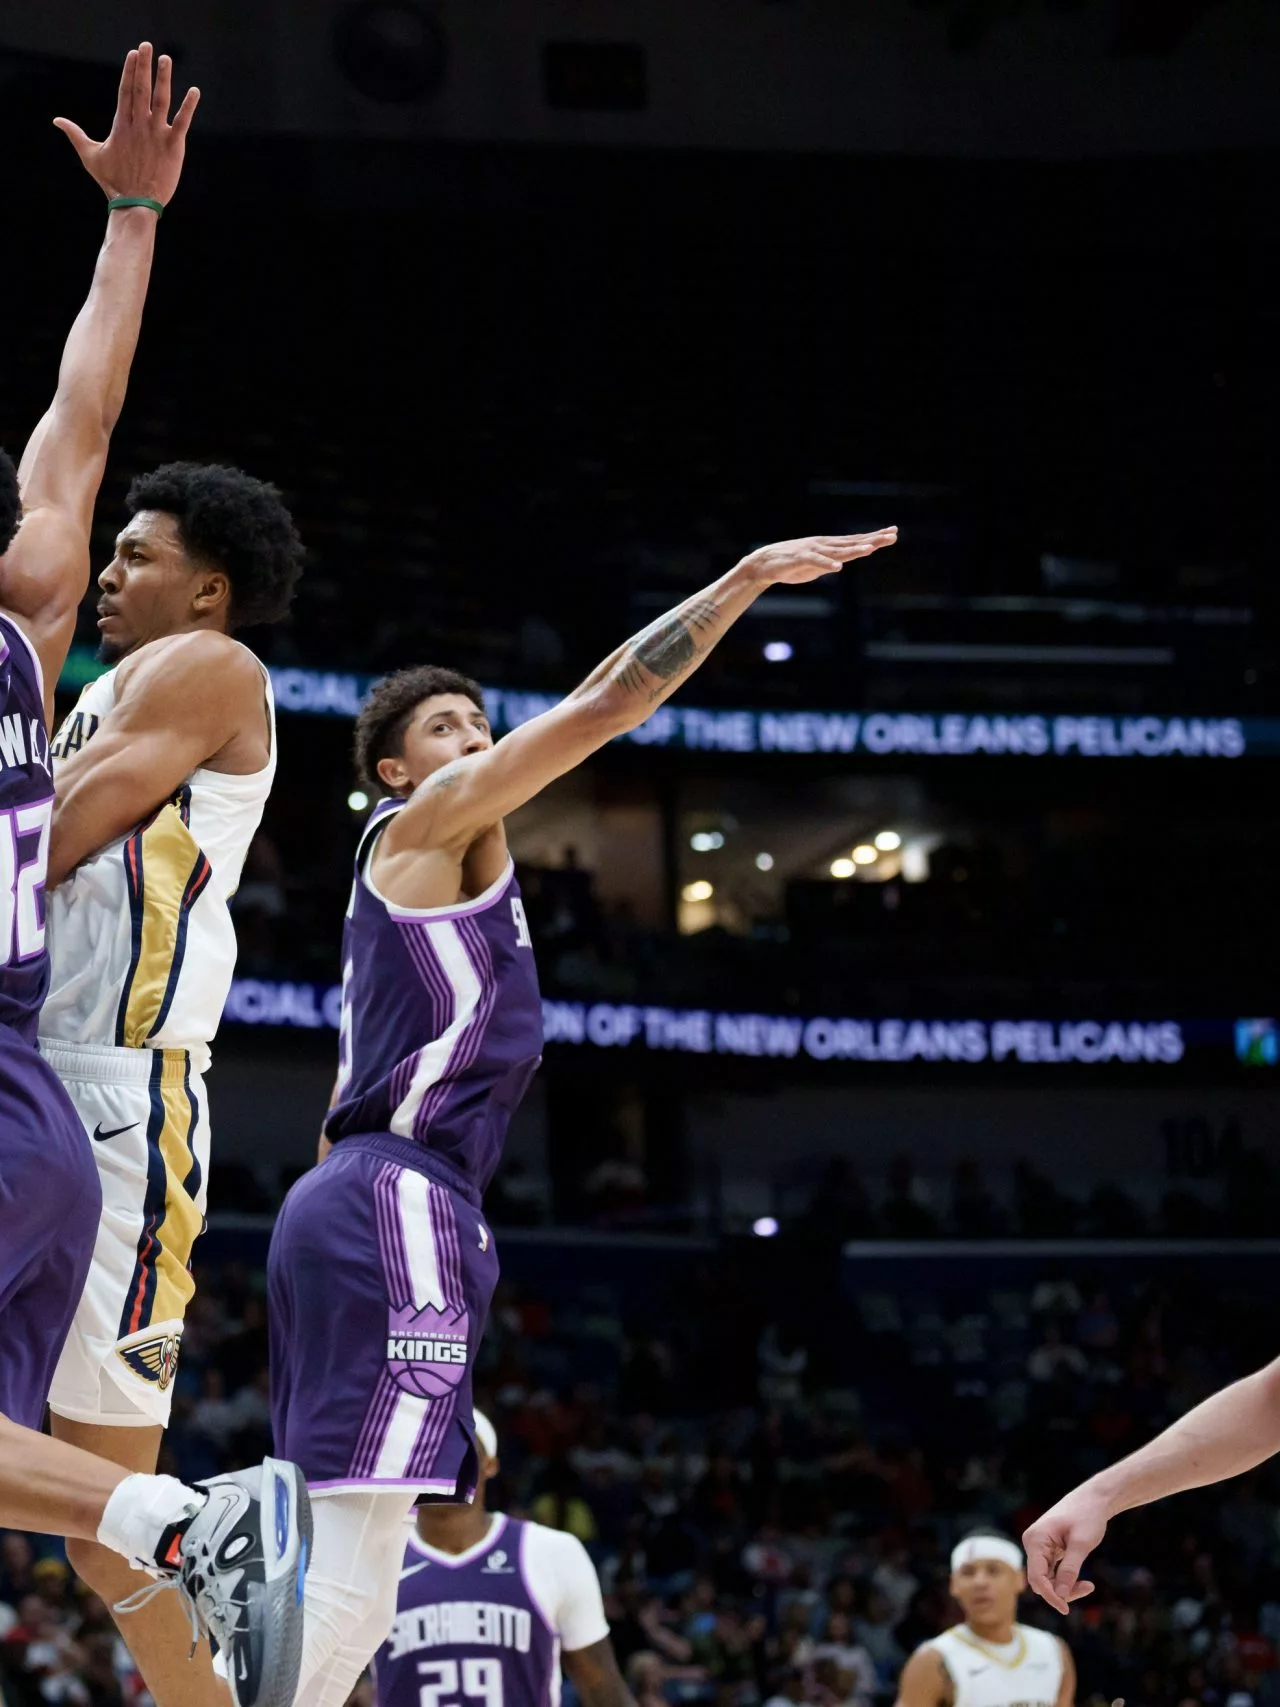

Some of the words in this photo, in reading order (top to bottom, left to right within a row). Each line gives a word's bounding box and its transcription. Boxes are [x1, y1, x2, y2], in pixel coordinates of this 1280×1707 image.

[682, 708, 756, 752] THE
[759, 711, 860, 753] NEW
[862, 713, 1050, 755] ORLEANS
[1053, 715, 1245, 757] PELICANS
[587, 1003, 641, 1047] OF
[642, 1007, 712, 1053] THE
[715, 1013, 802, 1058] NEW
[803, 1018, 988, 1061] ORLEANS
[991, 1021, 1184, 1063] PELICANS
[387, 1340, 467, 1364] KINGS
[390, 1331, 465, 1341] SACRAMENTO
[417, 1658, 504, 1707] 29
